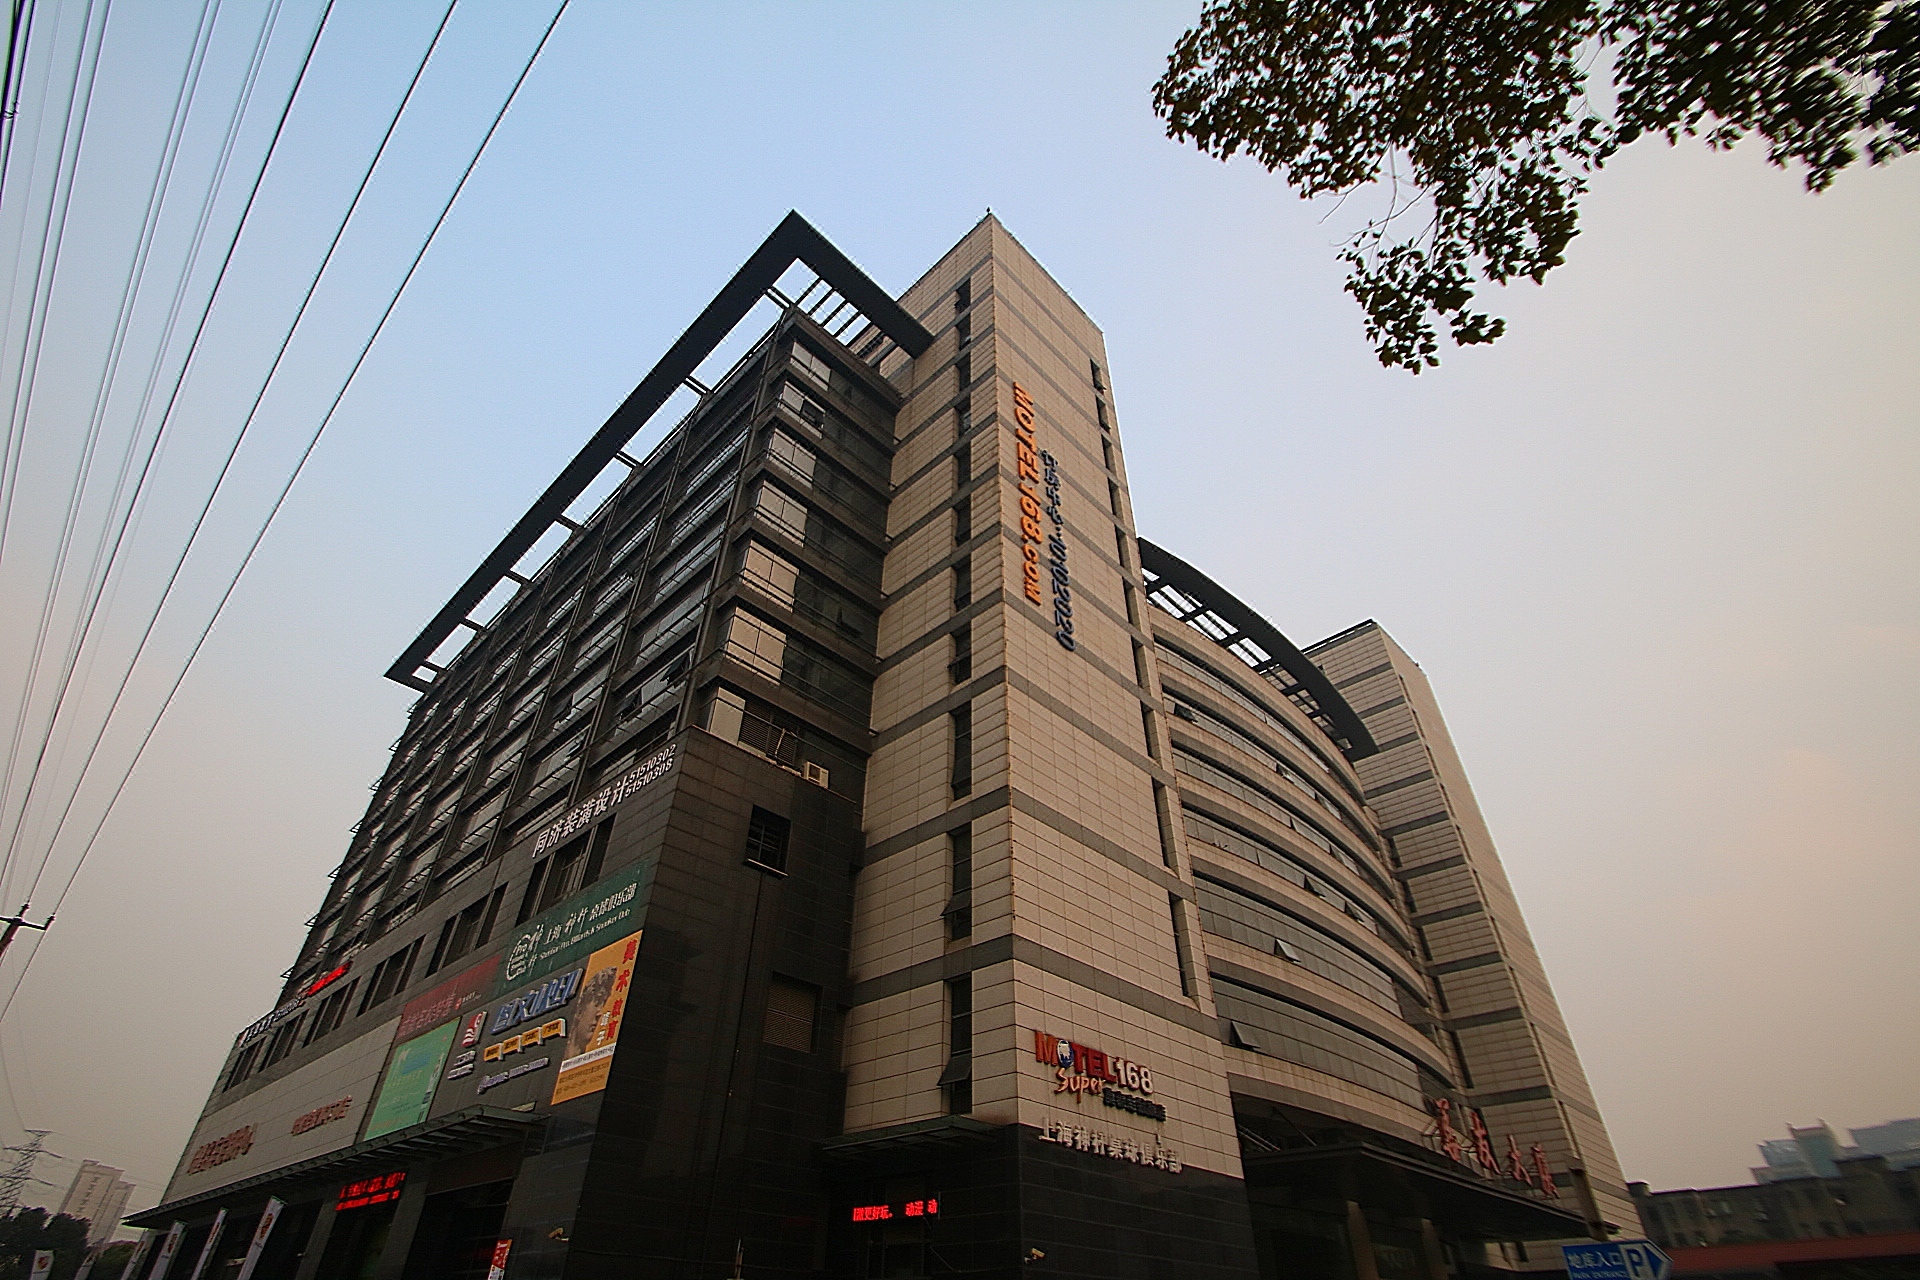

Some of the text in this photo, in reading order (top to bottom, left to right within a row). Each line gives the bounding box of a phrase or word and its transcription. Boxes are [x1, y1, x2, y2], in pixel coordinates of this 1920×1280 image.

[629, 743, 678, 784] 51510302
[606, 938, 638, 1041] 美术教育
[1054, 1067, 1106, 1104] Super
[1626, 1249, 1643, 1278] P
